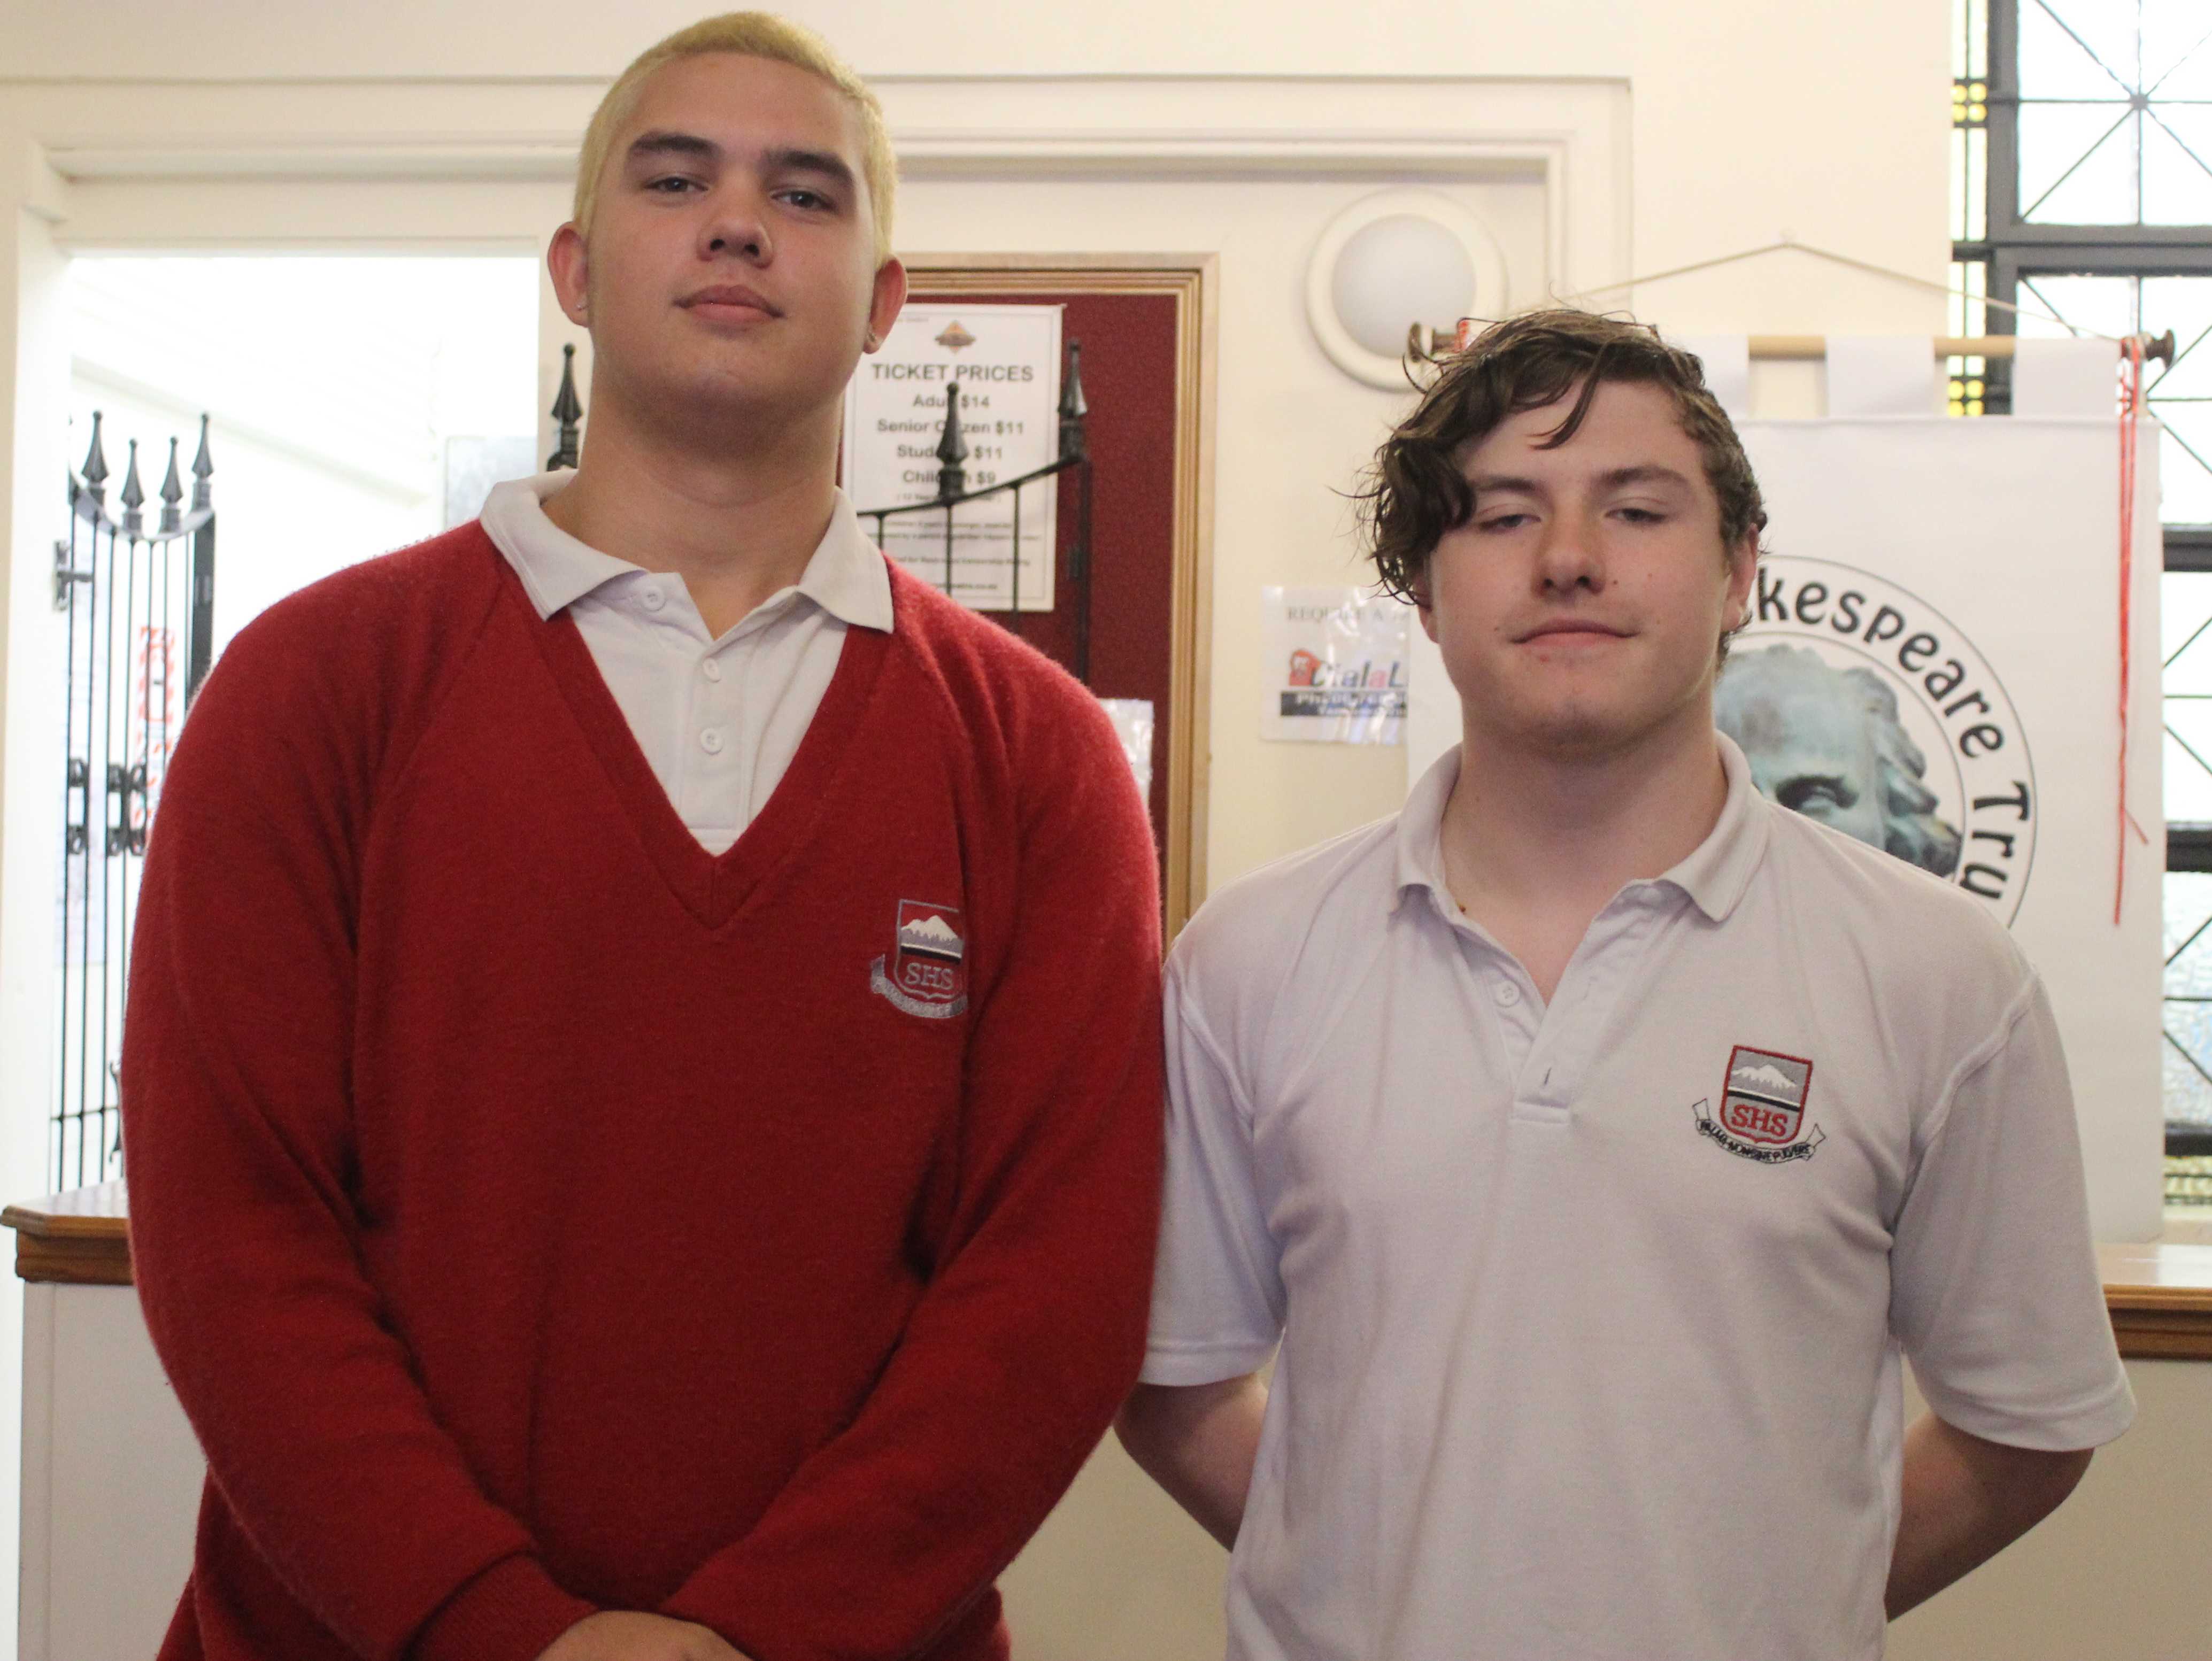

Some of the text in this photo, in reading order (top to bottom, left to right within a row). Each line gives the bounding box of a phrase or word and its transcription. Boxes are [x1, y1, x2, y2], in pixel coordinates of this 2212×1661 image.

[872, 364, 1034, 382] TICKET PRICES
[913, 394, 990, 410] Adu $14
[877, 419, 1024, 435] Senior Czen $11
[974, 445, 1003, 459] $11
[977, 470, 996, 485] $9
[904, 962, 954, 990] SHS
[1731, 1104, 1788, 1137] SHS
